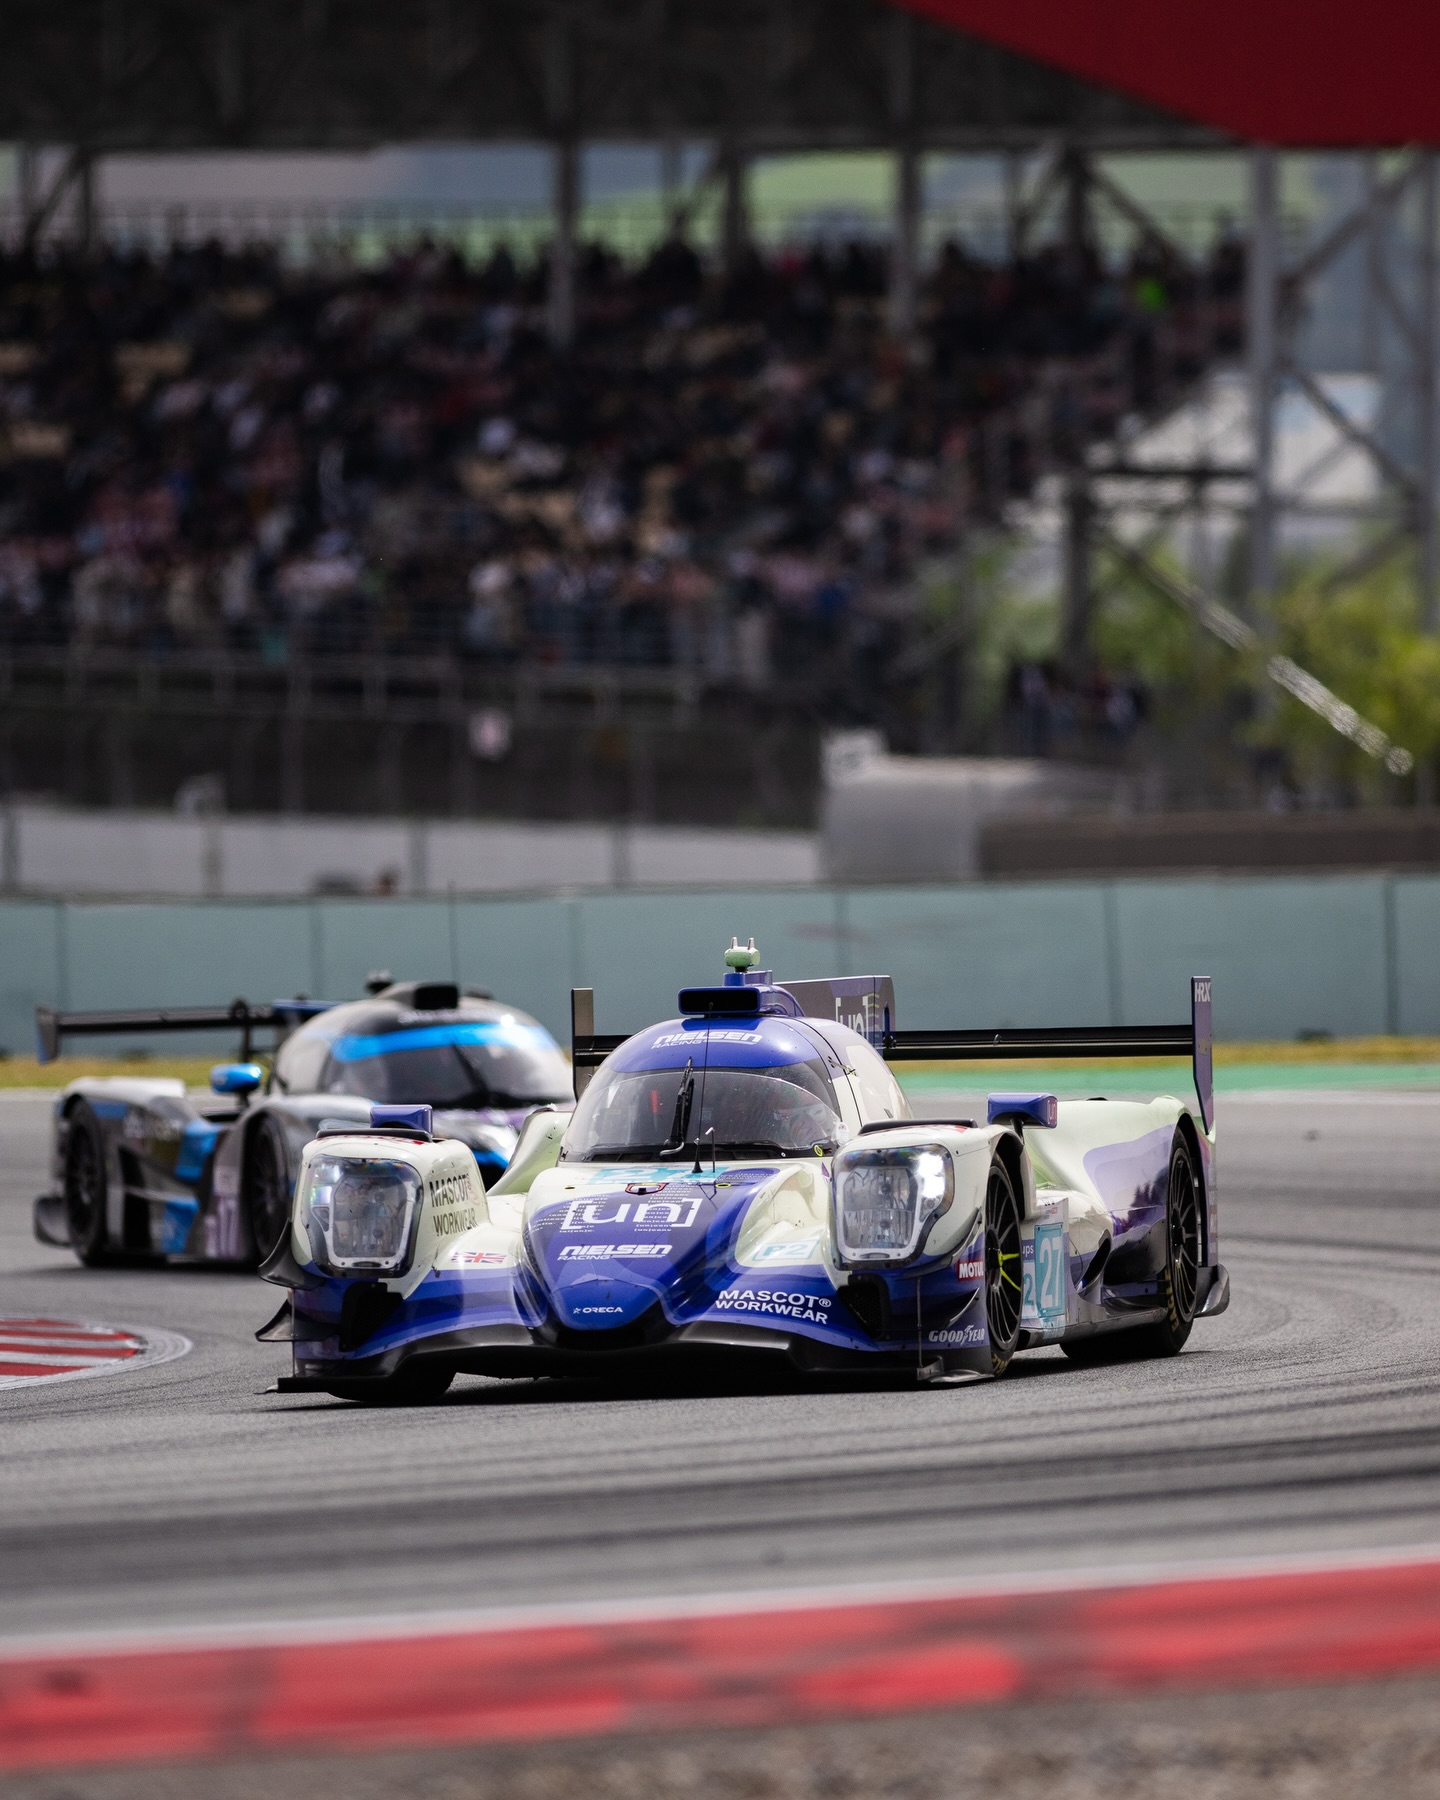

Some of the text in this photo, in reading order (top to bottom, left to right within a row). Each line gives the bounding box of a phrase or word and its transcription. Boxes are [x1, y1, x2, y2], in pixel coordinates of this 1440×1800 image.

[1194, 982, 1211, 1002] HRX
[653, 1031, 763, 1045] NIELSEN
[433, 1207, 478, 1237] WORKWEAR
[560, 1198, 703, 1230] [un]
[557, 1253, 612, 1261] RACING
[559, 1244, 673, 1256] NIELSEN
[762, 1244, 808, 1257] P2
[1039, 1236, 1063, 1310] 27
[582, 1306, 624, 1314] ORECA
[715, 1299, 829, 1325] WORKWEAR
[928, 1325, 985, 1345] GOODYEAR
